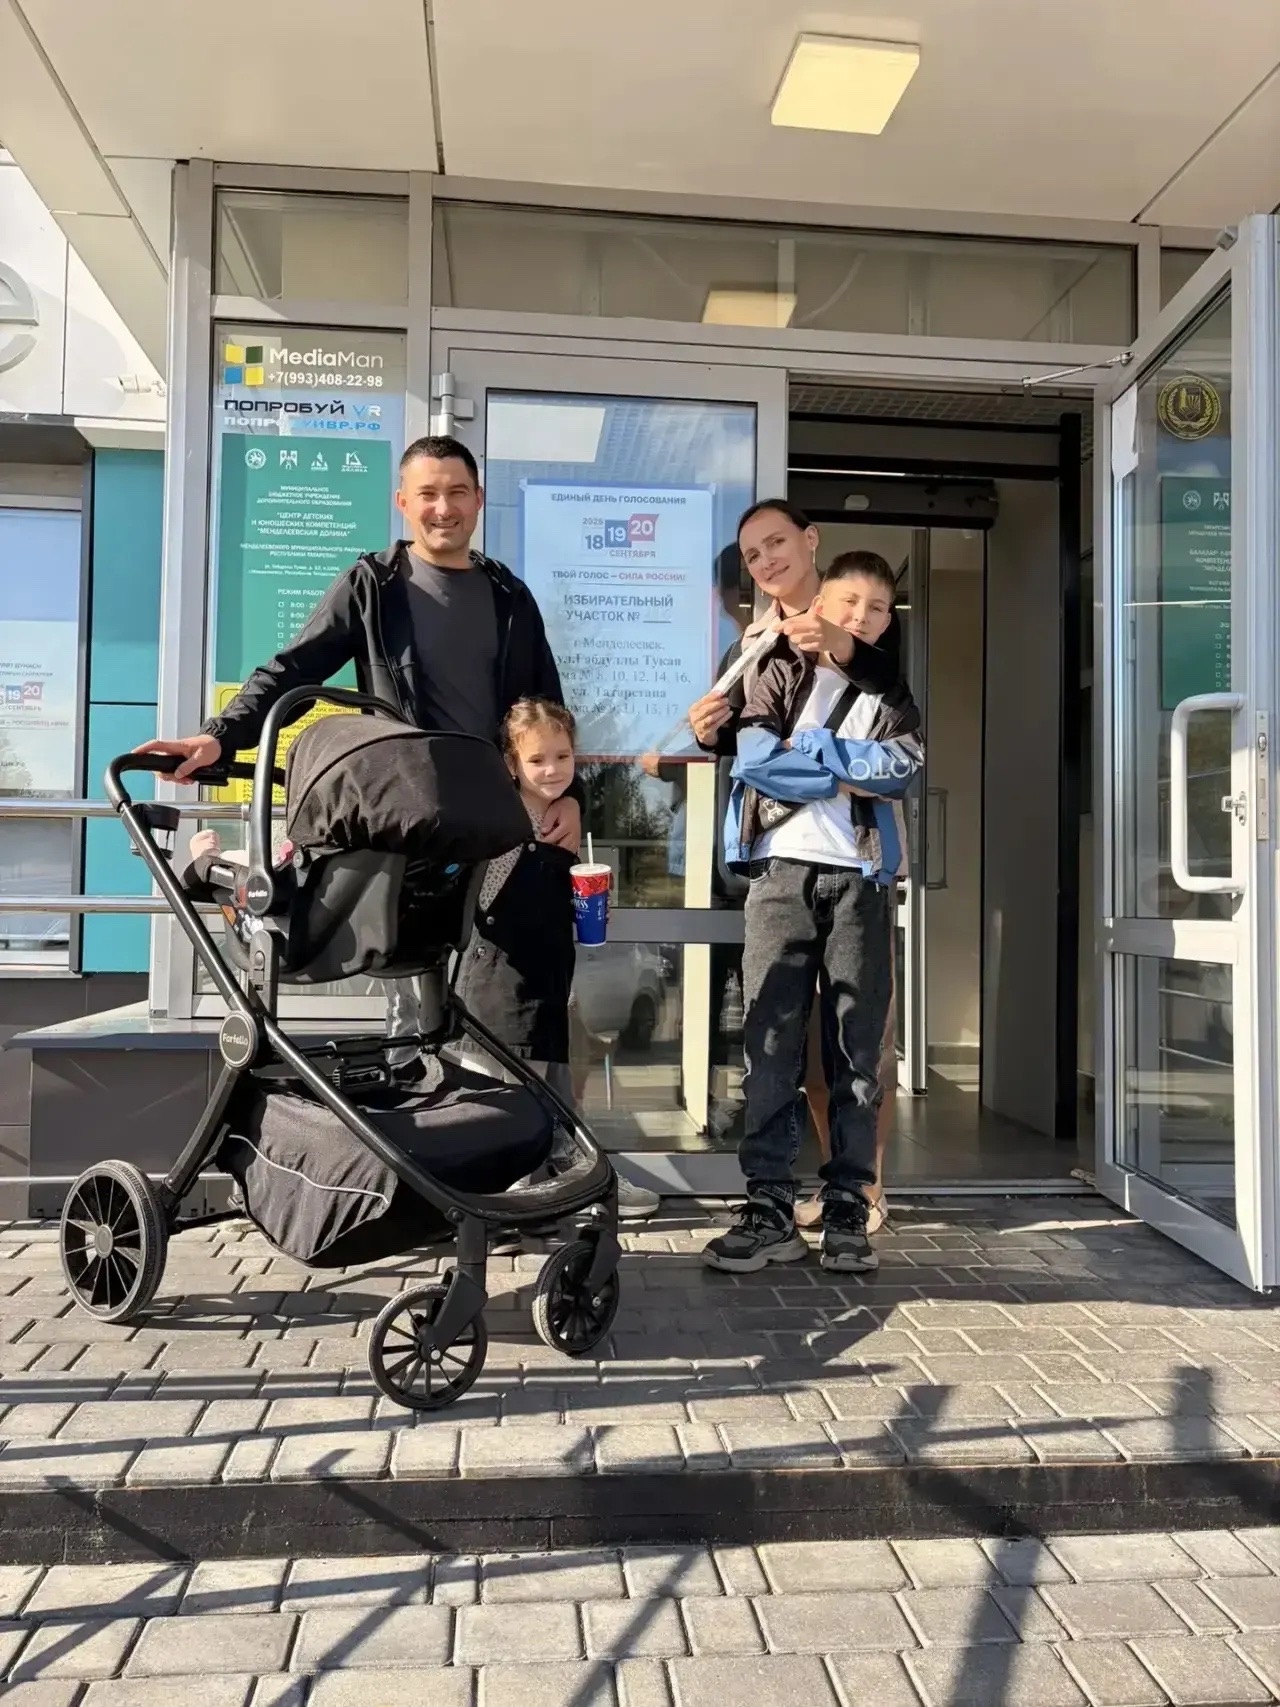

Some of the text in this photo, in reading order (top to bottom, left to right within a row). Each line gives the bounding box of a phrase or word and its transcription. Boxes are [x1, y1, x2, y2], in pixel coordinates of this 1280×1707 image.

[269, 348, 383, 368] MediaMan
[268, 371, 383, 388] +7(993)408-22-98
[224, 399, 381, 418] ПОПРОБУЙ VR
[551, 493, 687, 505] ЕДИНЫЙ ДЕНЬ ГОЛОСОВАНИЯ
[585, 519, 654, 550] 18 19 20
[609, 549, 656, 559] СЕНТЯБРЯ
[552, 569, 577, 579] ТВОЙ
[578, 571, 609, 580] ГОЛОС
[619, 571, 645, 581] СИЛА
[564, 593, 674, 608] ИЗБИРАТЕЛЬНЫЙ
[566, 610, 624, 622] УЧАСТОК
[627, 611, 641, 622] №
[8, 689, 21, 700] 19
[23, 685, 40, 696] 20
